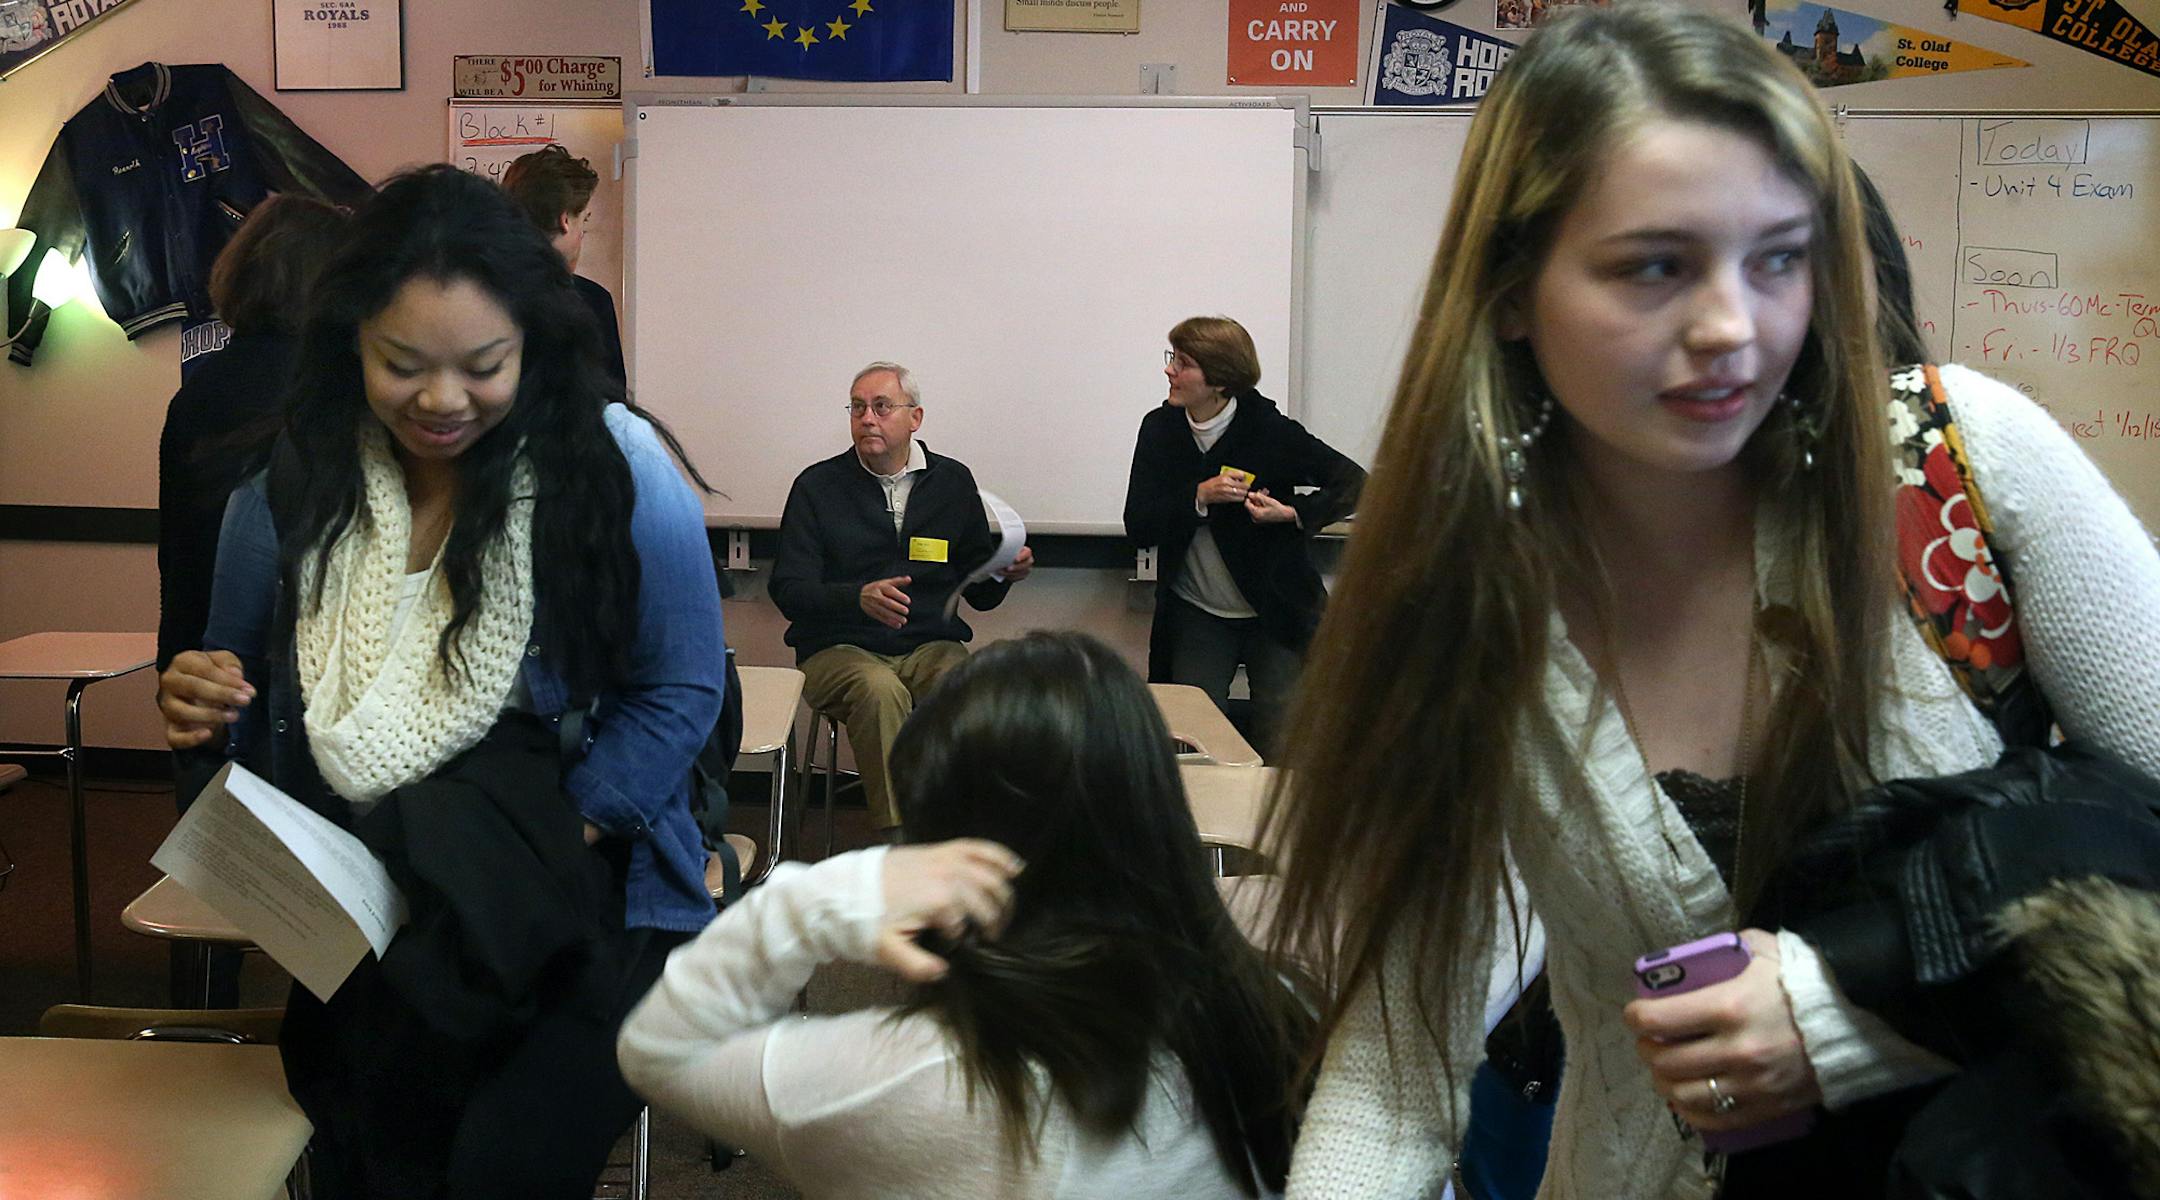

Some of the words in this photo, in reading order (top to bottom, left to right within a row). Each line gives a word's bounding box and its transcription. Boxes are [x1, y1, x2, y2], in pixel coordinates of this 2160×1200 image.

[304, 9, 369, 20] ROYALS
[1279, 2, 1308, 12] AND
[1247, 19, 1337, 41] CARRY
[2111, 17, 2160, 60] OLA
[1457, 34, 1517, 70] HOP
[1897, 38, 1916, 50] St.
[1921, 40, 1952, 52] Olaf
[547, 59, 606, 79] Charge
[1270, 49, 1313, 71] ON
[1895, 55, 1949, 72] College
[538, 79, 557, 92] for
[557, 79, 614, 95] Whining
[1452, 67, 1495, 98] RO
[460, 112, 530, 139] Block
[1984, 120, 2078, 172] Today
[1985, 174, 2036, 197] Unit
[2047, 174, 2061, 197] 4
[2072, 173, 2133, 199] Exam
[1967, 253, 2051, 288] Soon
[182, 320, 231, 363] HOP
[2088, 336, 2140, 366] FRQ
